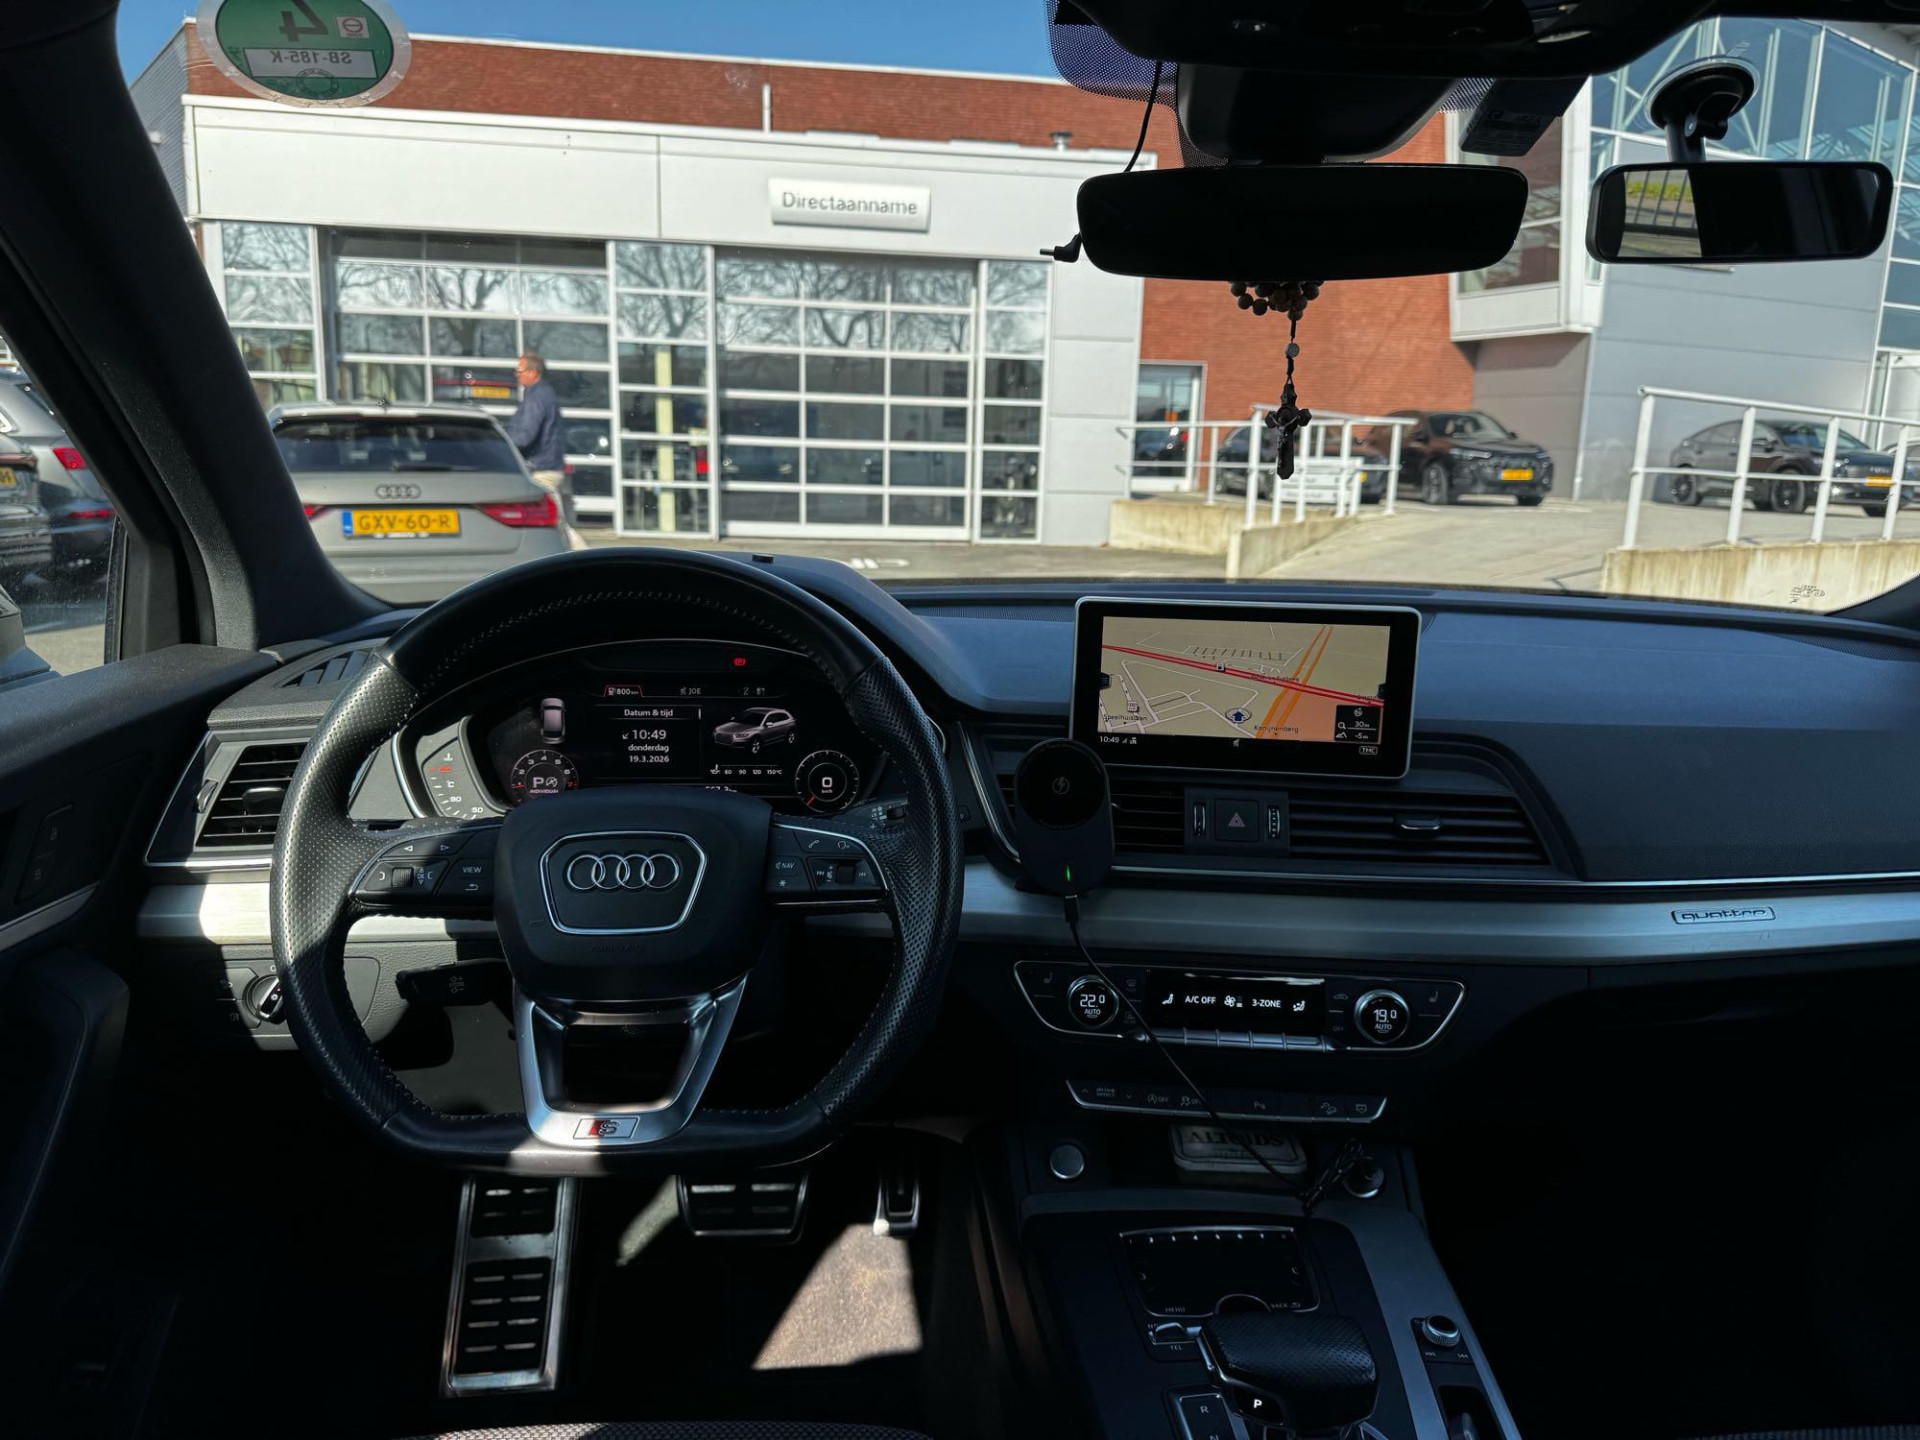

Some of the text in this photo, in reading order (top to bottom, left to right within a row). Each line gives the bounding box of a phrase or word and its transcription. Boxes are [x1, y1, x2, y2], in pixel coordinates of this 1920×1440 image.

[782, 192, 917, 215] Directaanname
[358, 514, 451, 530] GXV-60-R
[660, 709, 674, 718] tijd
[632, 729, 667, 740] 10:49
[628, 744, 669, 753] donderdag
[629, 755, 670, 763] 19.3.2026
[533, 777, 544, 788] P
[822, 777, 833, 788] 0
[1681, 909, 1766, 920] quattro
[1185, 996, 1216, 1004] A/C OFF
[1252, 998, 1281, 1008] 3-ZONE
[1253, 1398, 1263, 1409] P
[1200, 1405, 1209, 1414] R
